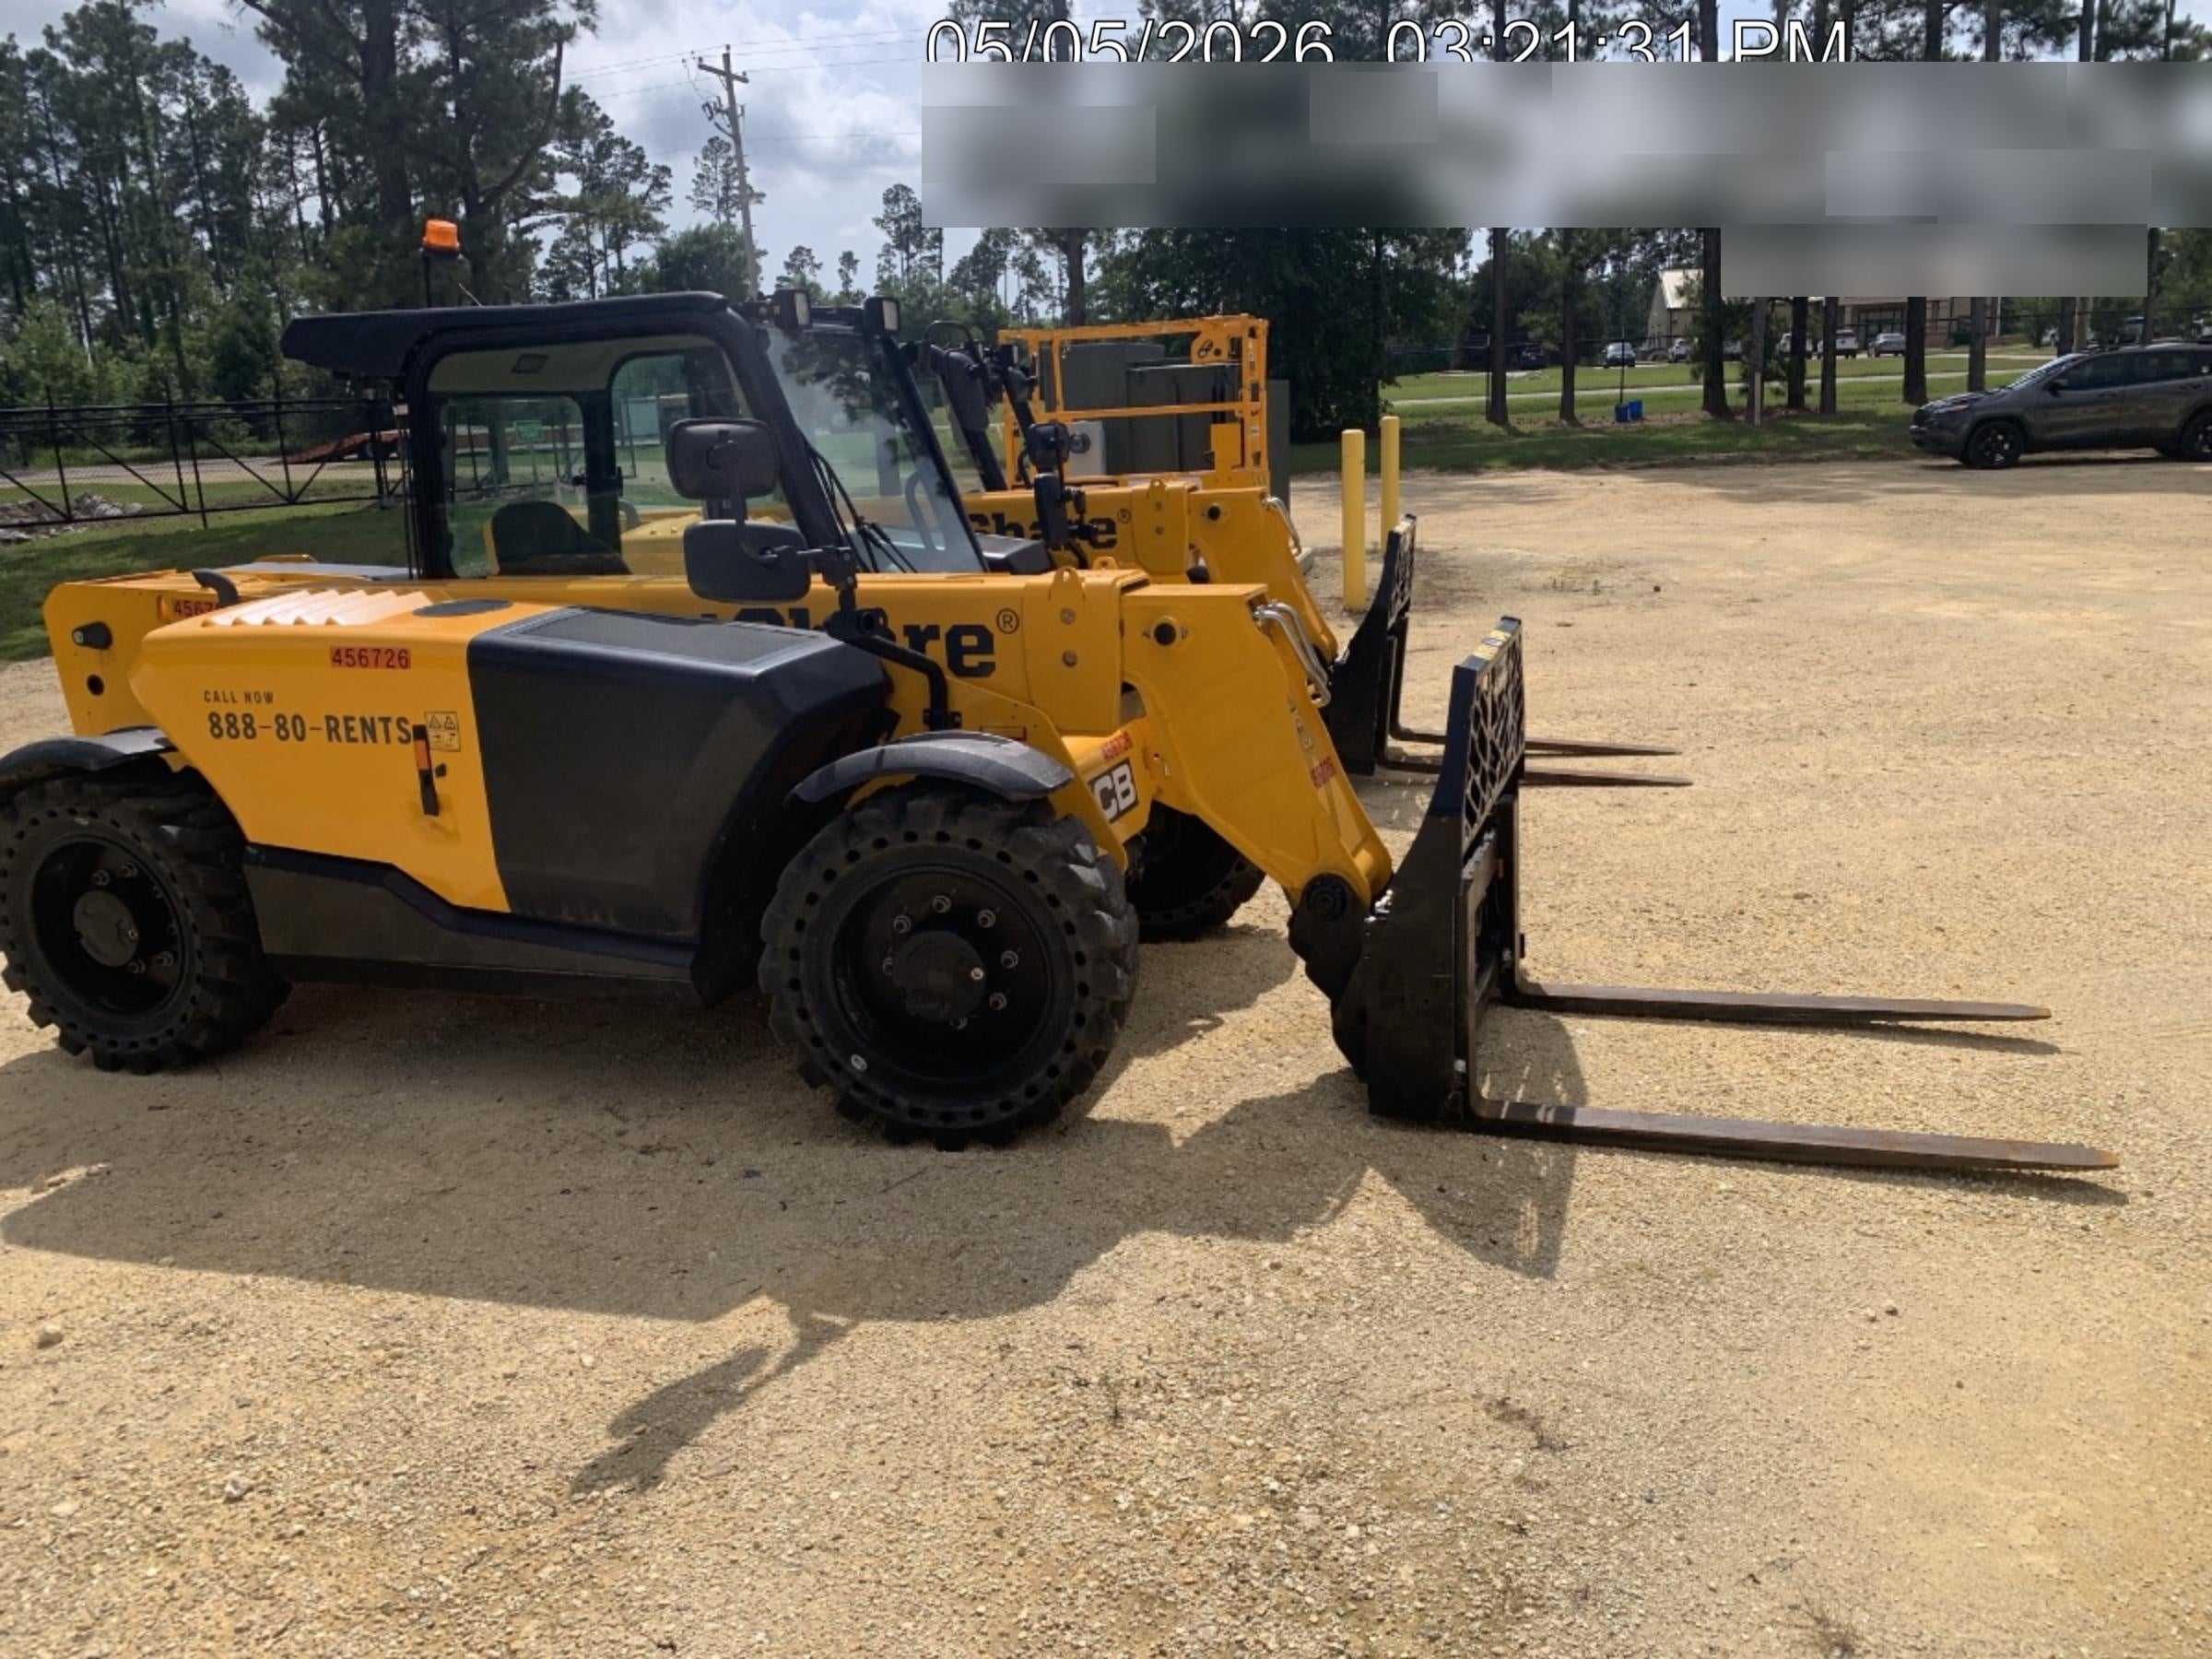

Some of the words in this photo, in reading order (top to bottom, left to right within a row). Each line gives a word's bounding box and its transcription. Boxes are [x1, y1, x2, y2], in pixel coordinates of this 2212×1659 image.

[331, 647, 409, 669] 456726
[204, 690, 238, 703] CALL
[243, 690, 274, 704] NOW
[208, 712, 412, 745] 888-80-RENTS
[1091, 763, 1136, 821] CB
